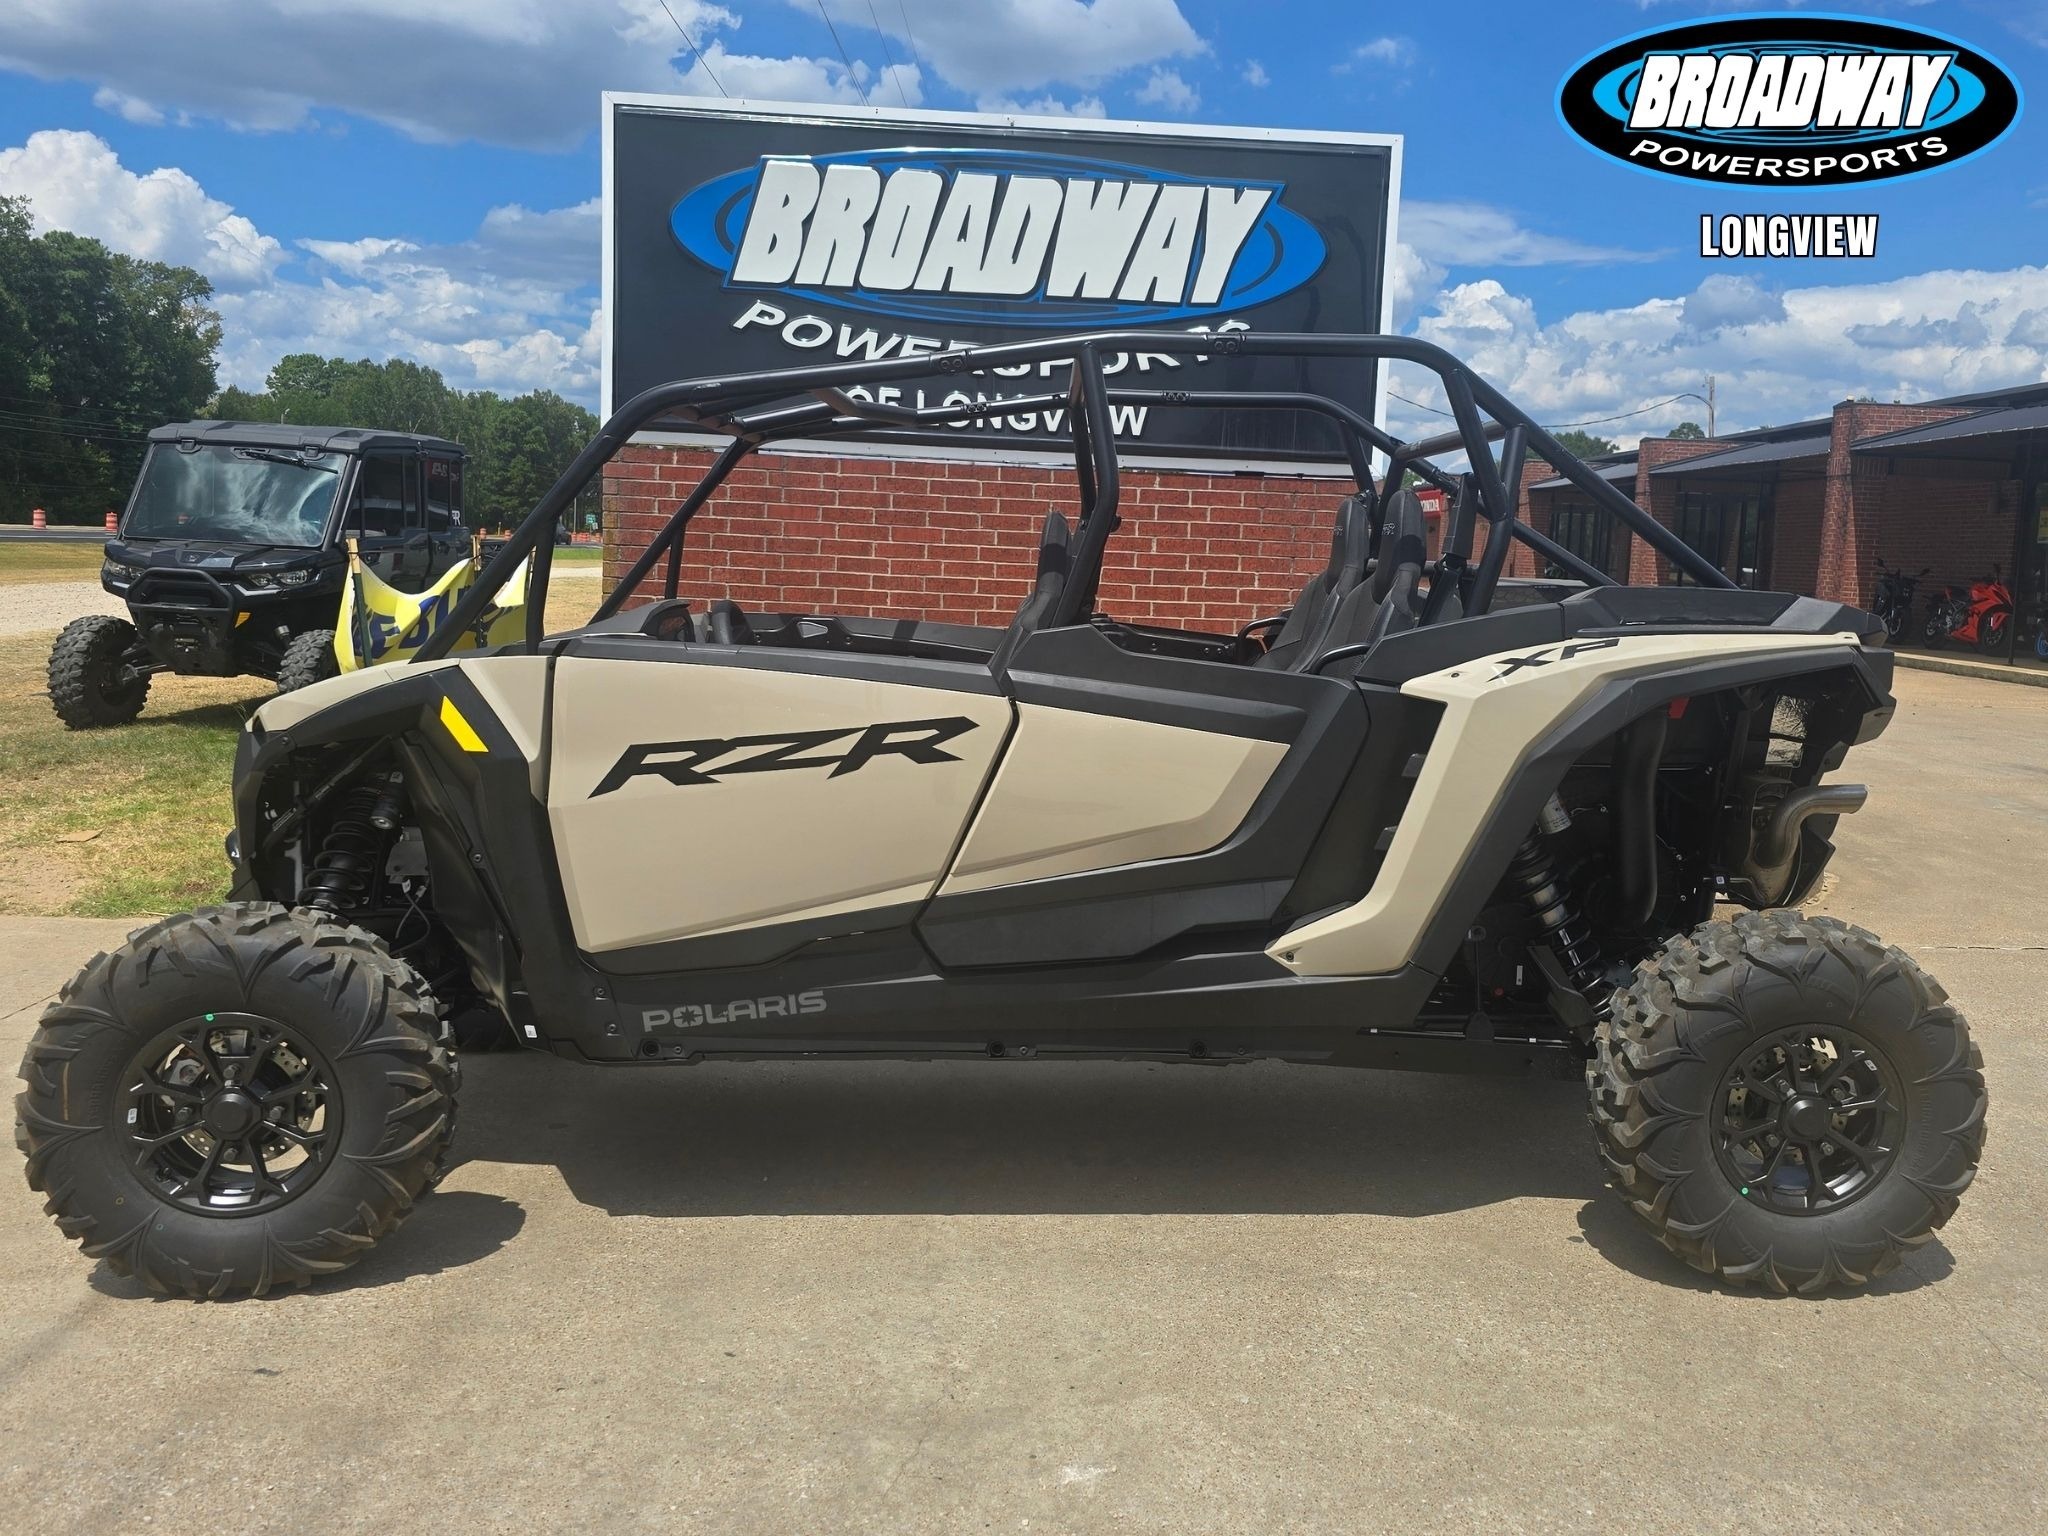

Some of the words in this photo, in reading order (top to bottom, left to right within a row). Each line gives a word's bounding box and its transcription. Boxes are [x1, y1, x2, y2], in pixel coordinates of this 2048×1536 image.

[732, 156, 1273, 304] BROADWAY
[916, 389, 1148, 436] LONGVW
[1420, 498, 1441, 513] ONDA
[1486, 638, 1620, 683] XP
[587, 716, 981, 800] RZR
[642, 990, 828, 1032] POLARIS
